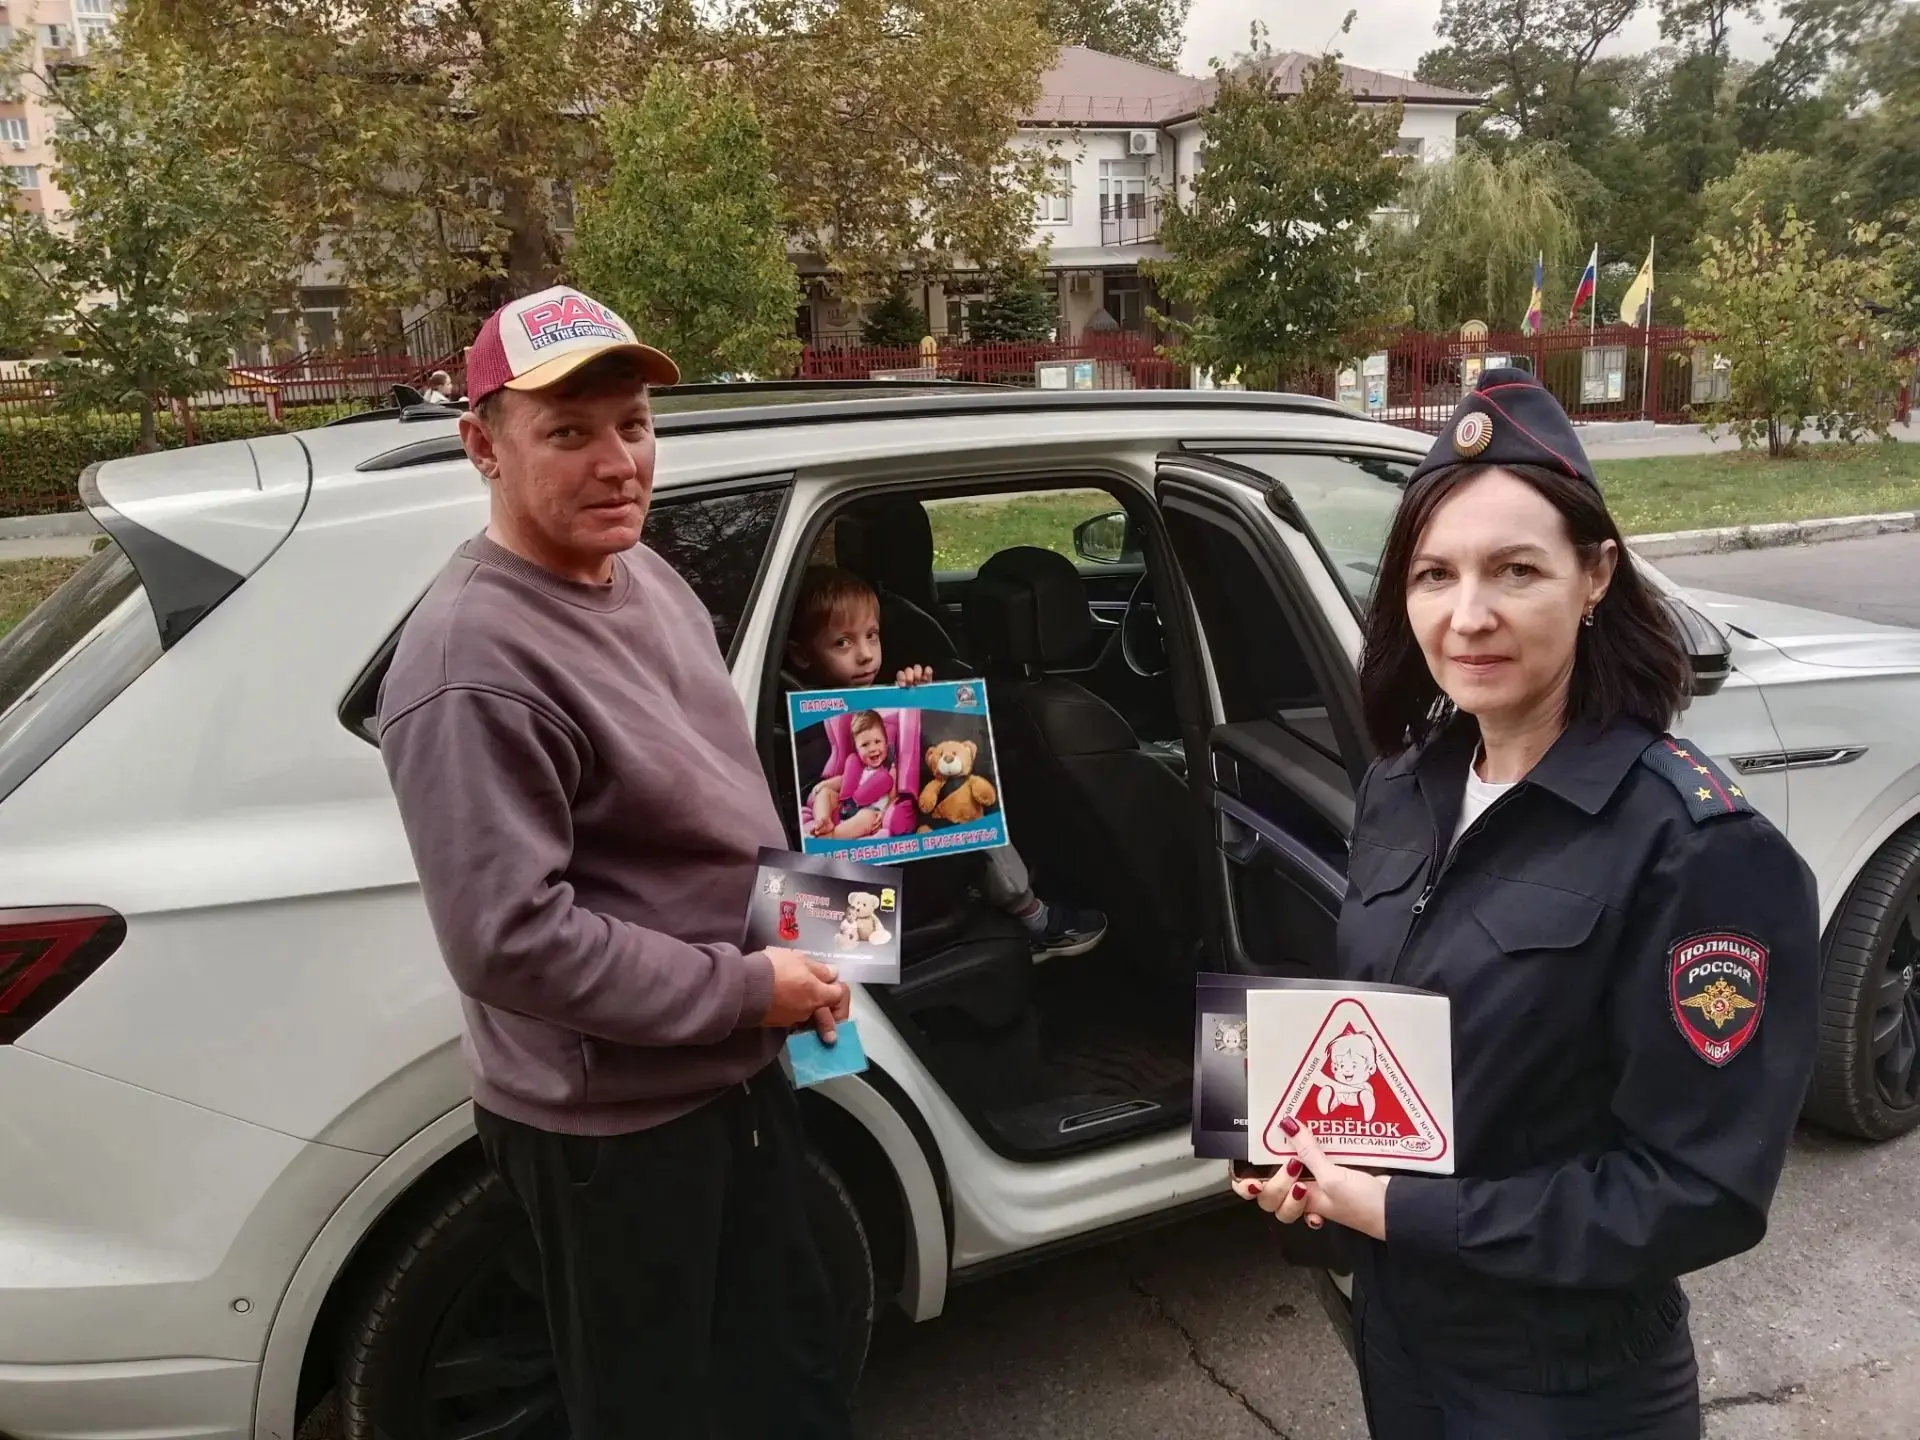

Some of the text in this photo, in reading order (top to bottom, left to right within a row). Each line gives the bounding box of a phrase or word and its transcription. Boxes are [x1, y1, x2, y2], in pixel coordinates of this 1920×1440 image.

[532, 334, 555, 349] FEEL
[554, 328, 576, 341] THE
[575, 325, 613, 338] FISHING
[800, 697, 848, 712] ПАПОЧКА,
[890, 839, 919, 856] МЕНЯ
[923, 828, 998, 851] ПРИСТЕГНУТЬ?
[1680, 941, 1760, 967] ПОЛИЦИЯ
[1688, 961, 1752, 986] РОССИЯ
[1704, 1041, 1730, 1059] МВД
[1281, 1057, 1320, 1120] АВТОИНСПЕКЦИЯ
[1378, 1053, 1421, 1119] КРАСНОДАРСКОГО
[1307, 1117, 1401, 1137] РЕБЁНОК
[1339, 1136, 1398, 1147] ПАССАЖИР
